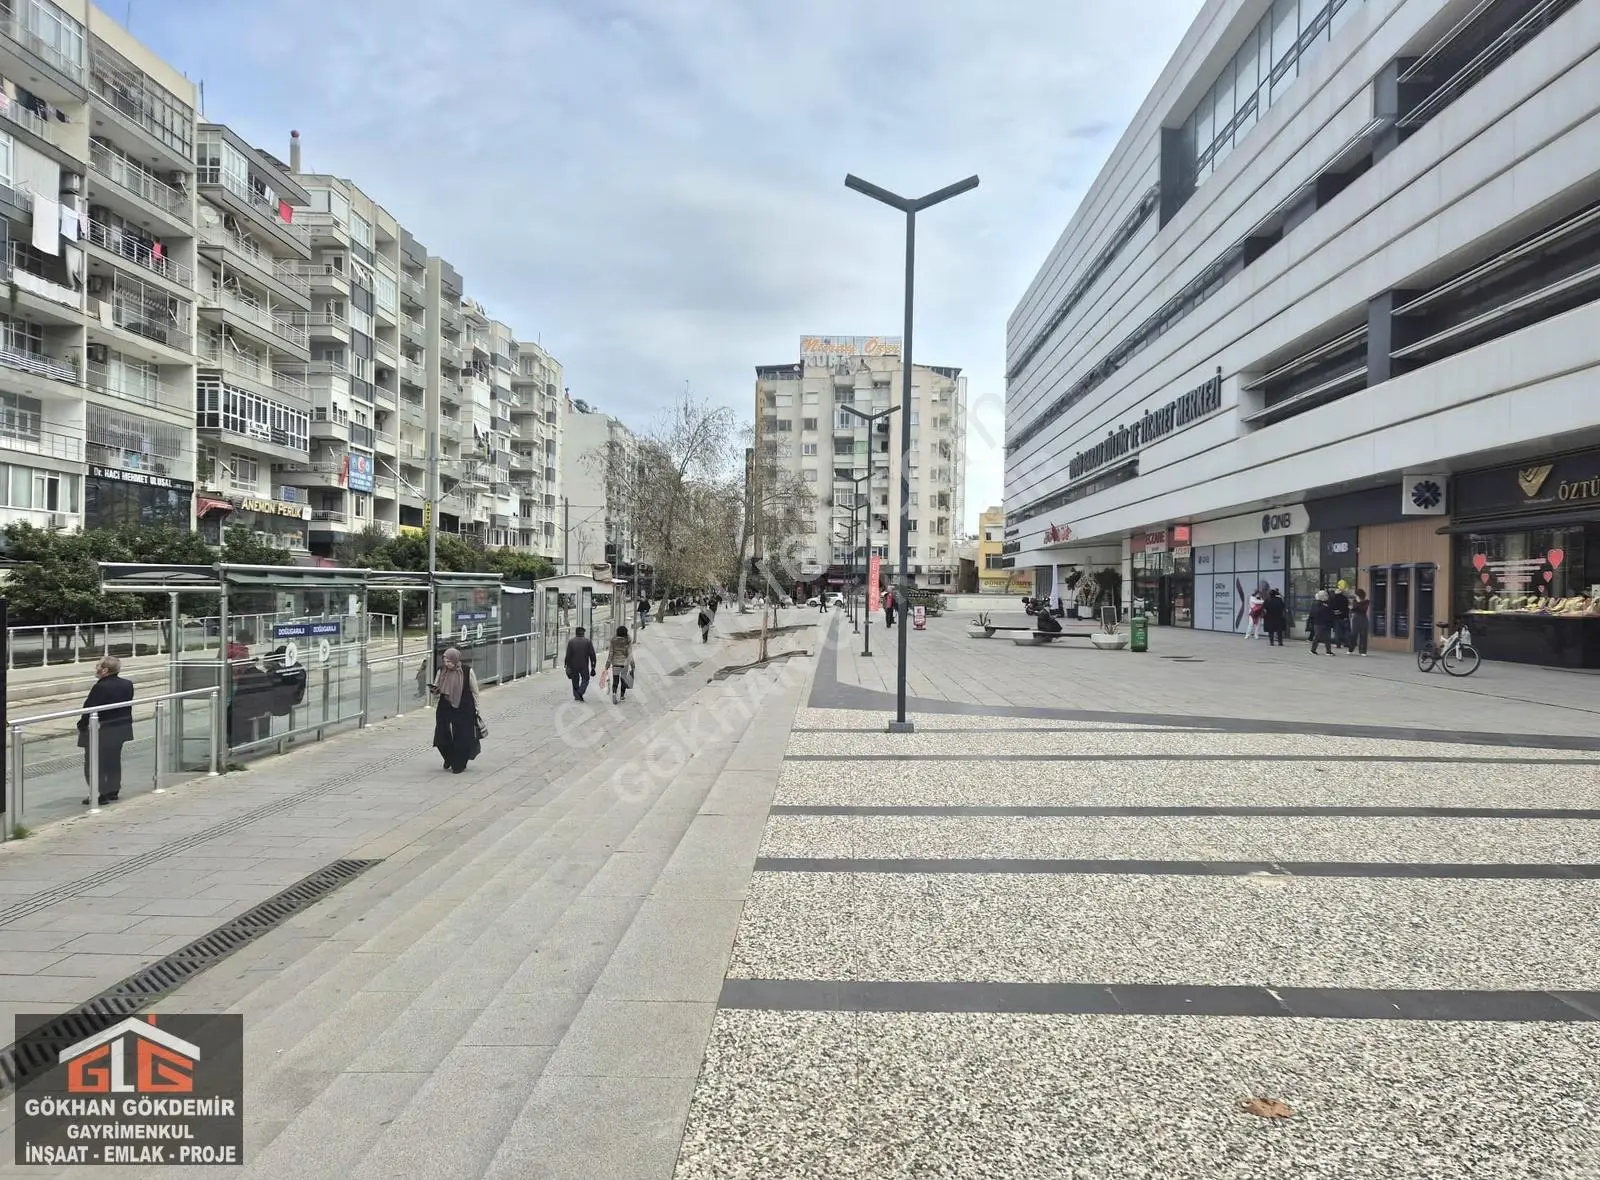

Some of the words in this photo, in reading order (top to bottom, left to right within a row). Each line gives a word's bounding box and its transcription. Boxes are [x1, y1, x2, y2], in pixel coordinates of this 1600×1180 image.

[1104, 424, 1130, 463] KÜLTÜR
[1130, 420, 1141, 449] VE
[1141, 408, 1176, 444] TİCARET
[1176, 366, 1222, 427] MERKEZİ
[93, 467, 103, 477] Dr.
[121, 471, 149, 484] MEHMET
[1558, 475, 1600, 502] ÖZTÜ
[241, 496, 276, 515] ANEMON
[1271, 513, 1290, 531] QNB
[1333, 542, 1349, 553] QNB
